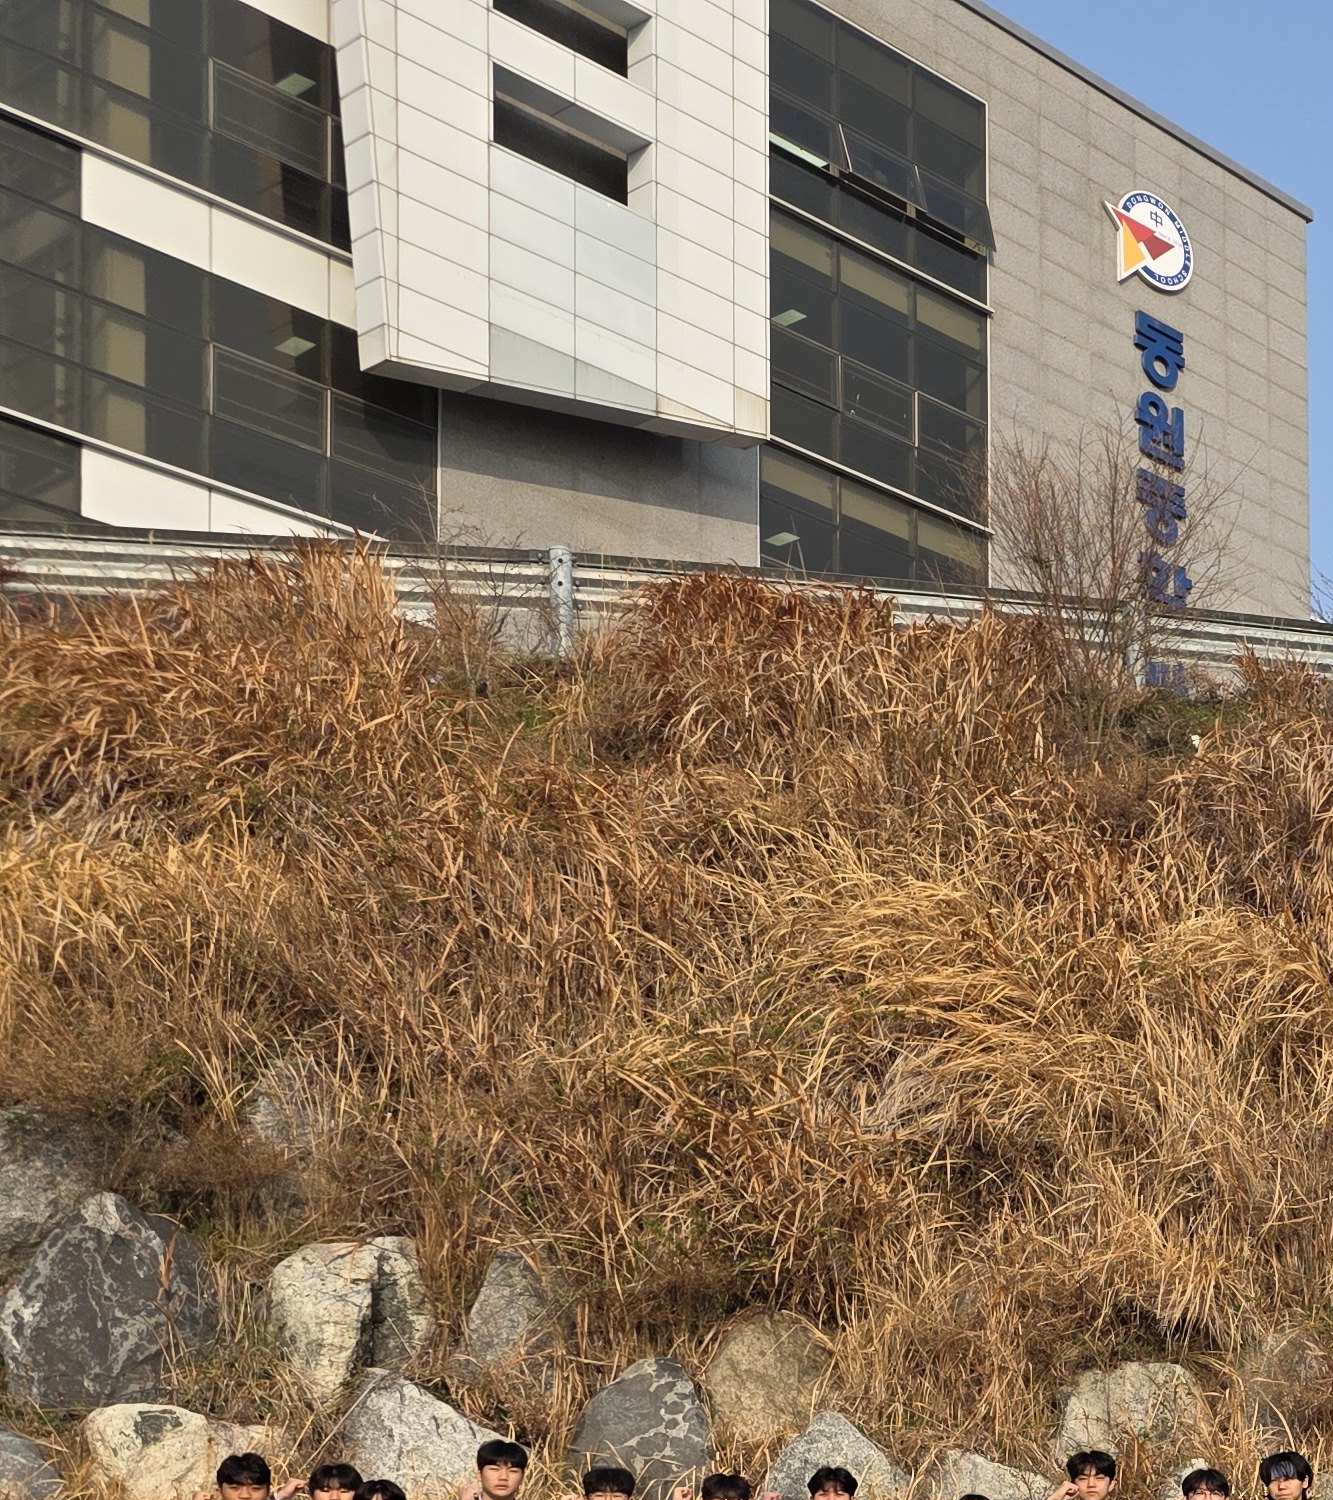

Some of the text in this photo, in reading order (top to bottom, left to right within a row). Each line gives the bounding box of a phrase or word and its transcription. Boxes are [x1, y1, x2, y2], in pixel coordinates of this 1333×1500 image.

[1126, 195, 1171, 216] DONGWON
[1149, 211, 1163, 228] 中
[1174, 220, 1191, 267] MIDDLE
[1154, 270, 1187, 285] SCHOOL
